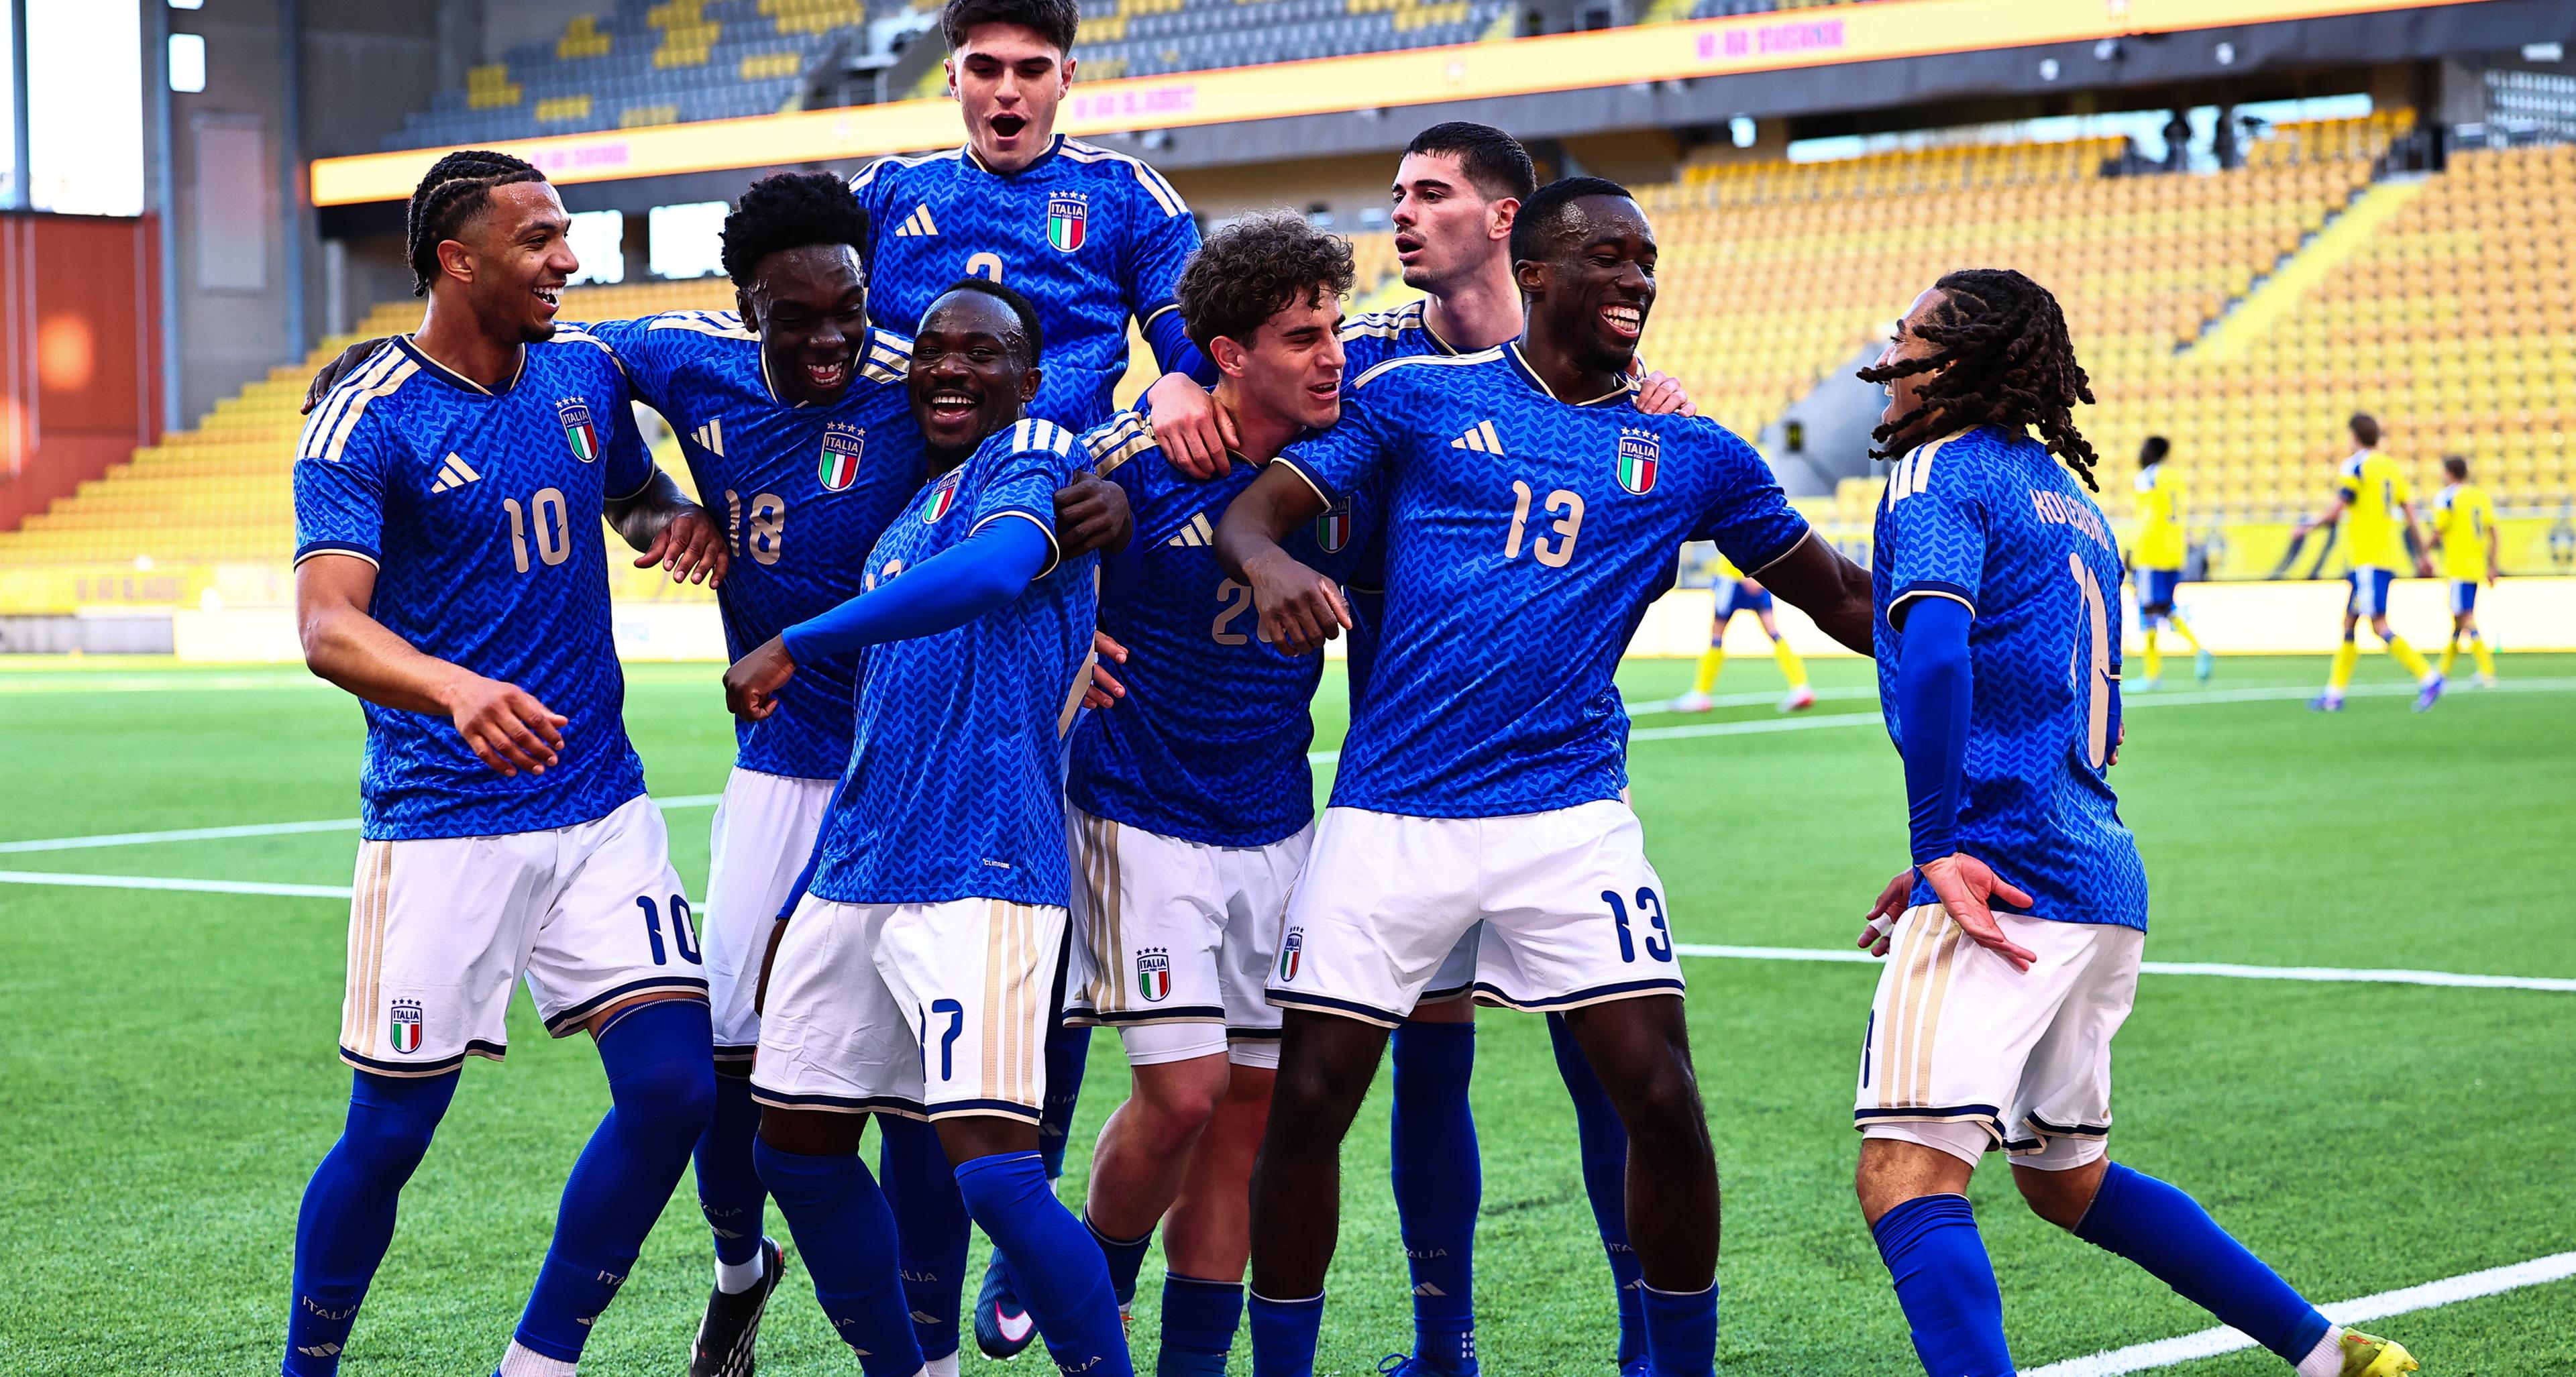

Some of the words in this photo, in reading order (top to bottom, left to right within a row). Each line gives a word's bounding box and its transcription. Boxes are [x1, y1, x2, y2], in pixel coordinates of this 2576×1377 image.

[1051, 203, 1083, 217] ITALIA
[563, 410, 588, 425] ITALIA
[826, 436, 858, 453] ITALIA
[1622, 441, 1655, 458] ITALIA
[503, 488, 570, 573] 10
[724, 489, 785, 565] 18
[1504, 480, 1585, 567] 13
[636, 894, 702, 966] 10
[1601, 887, 1672, 963] 13
[1140, 958, 1167, 970] ITALIA
[393, 1010, 419, 1020] ITALIA
